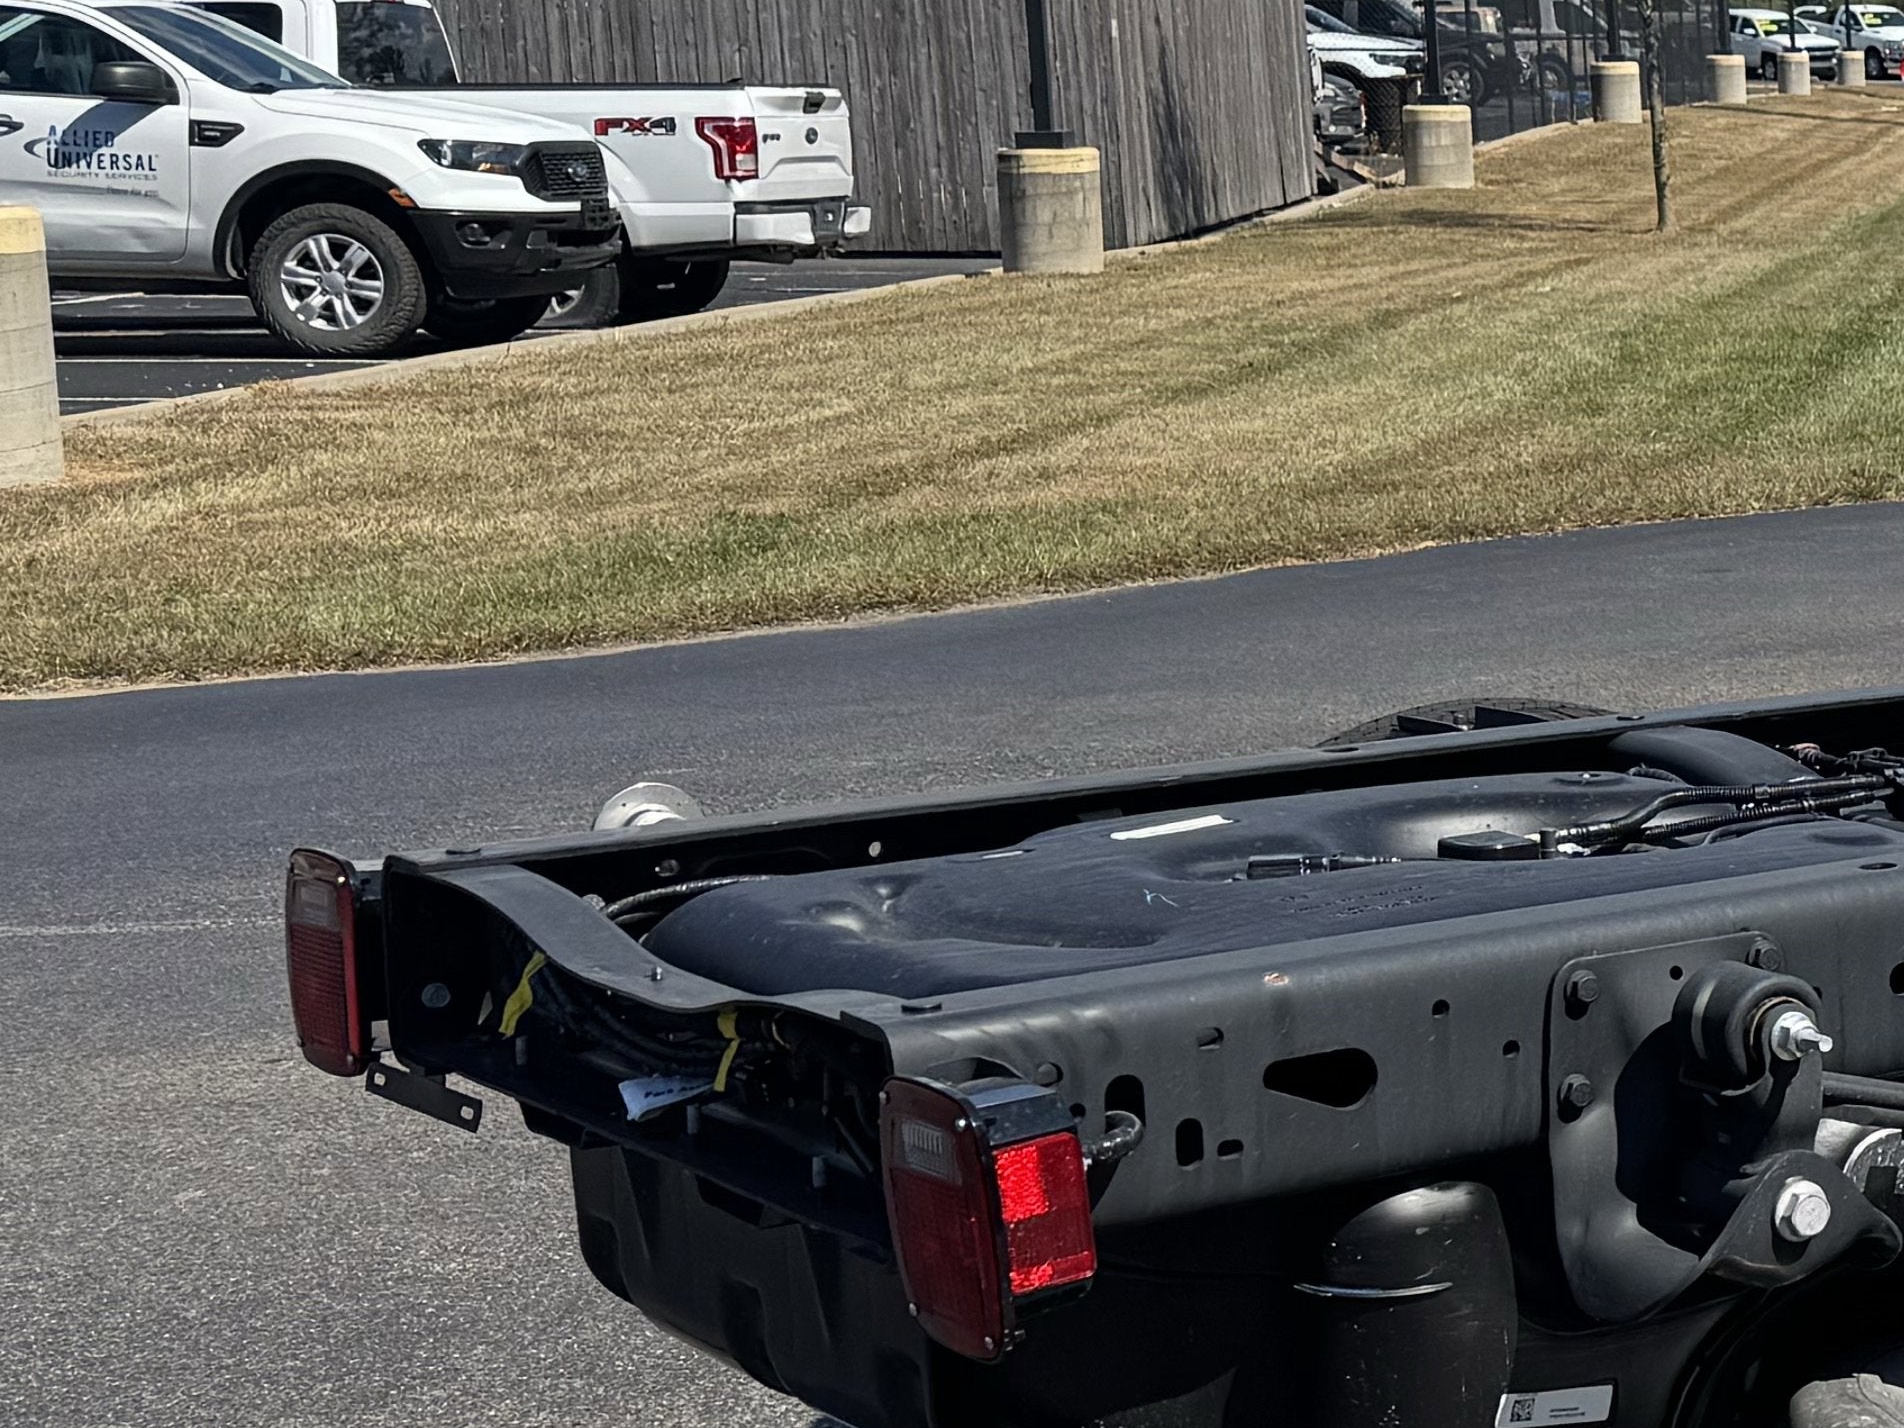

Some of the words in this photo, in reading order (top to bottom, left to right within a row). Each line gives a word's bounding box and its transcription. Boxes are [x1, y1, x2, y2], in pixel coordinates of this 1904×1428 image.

[47, 125, 115, 148] ALLIED
[594, 116, 677, 136] FX4
[47, 147, 157, 171] UNIVERSAL
[47, 170, 99, 179] SECURITY
[105, 173, 158, 181] SERVICES
